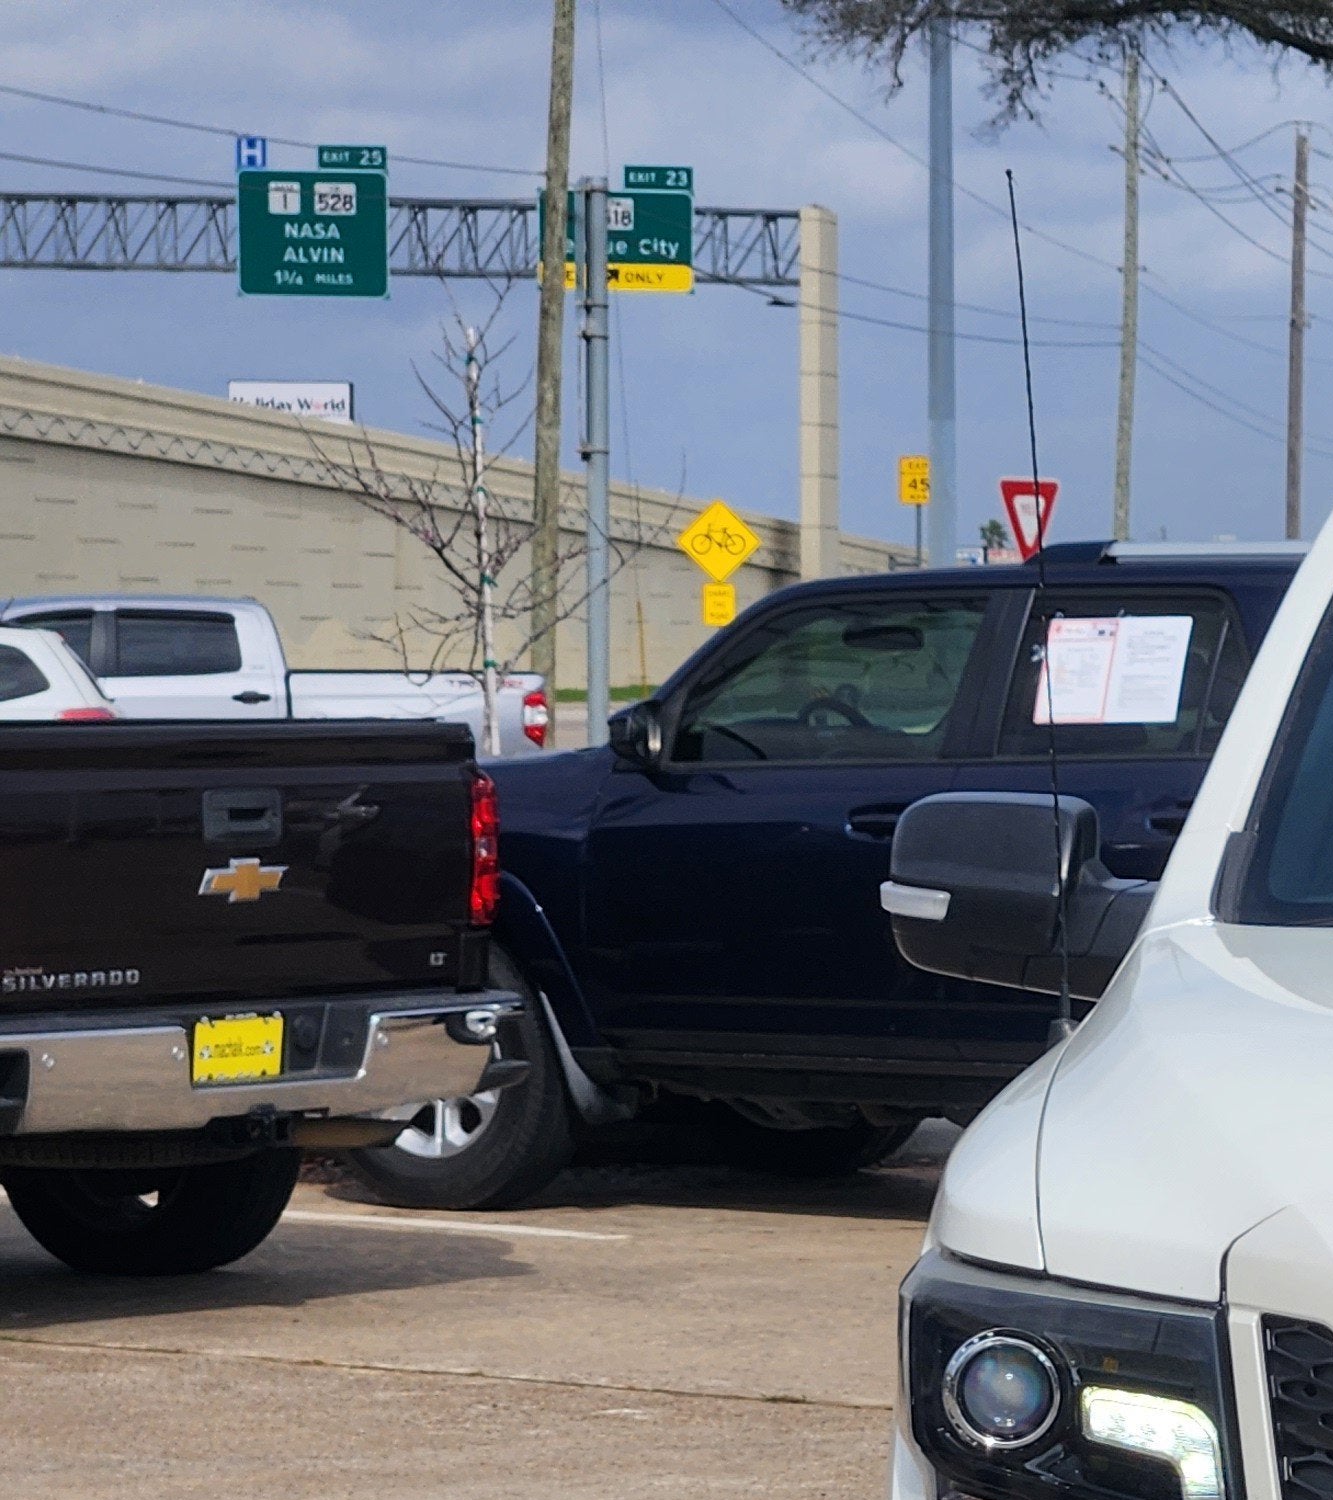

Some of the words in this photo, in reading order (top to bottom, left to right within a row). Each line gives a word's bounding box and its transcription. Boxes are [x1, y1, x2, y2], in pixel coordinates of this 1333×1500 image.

[321, 151, 350, 163] EXIT
[359, 149, 383, 166] 25
[628, 171, 657, 183] EXIT
[666, 170, 689, 187] 23
[317, 193, 354, 212] 528
[284, 221, 341, 240] NASA
[282, 246, 345, 264] ALVIN
[638, 237, 680, 260] City
[314, 272, 354, 286] MILES
[624, 270, 665, 284] ONLY
[2, 968, 140, 992] SILVERADO
